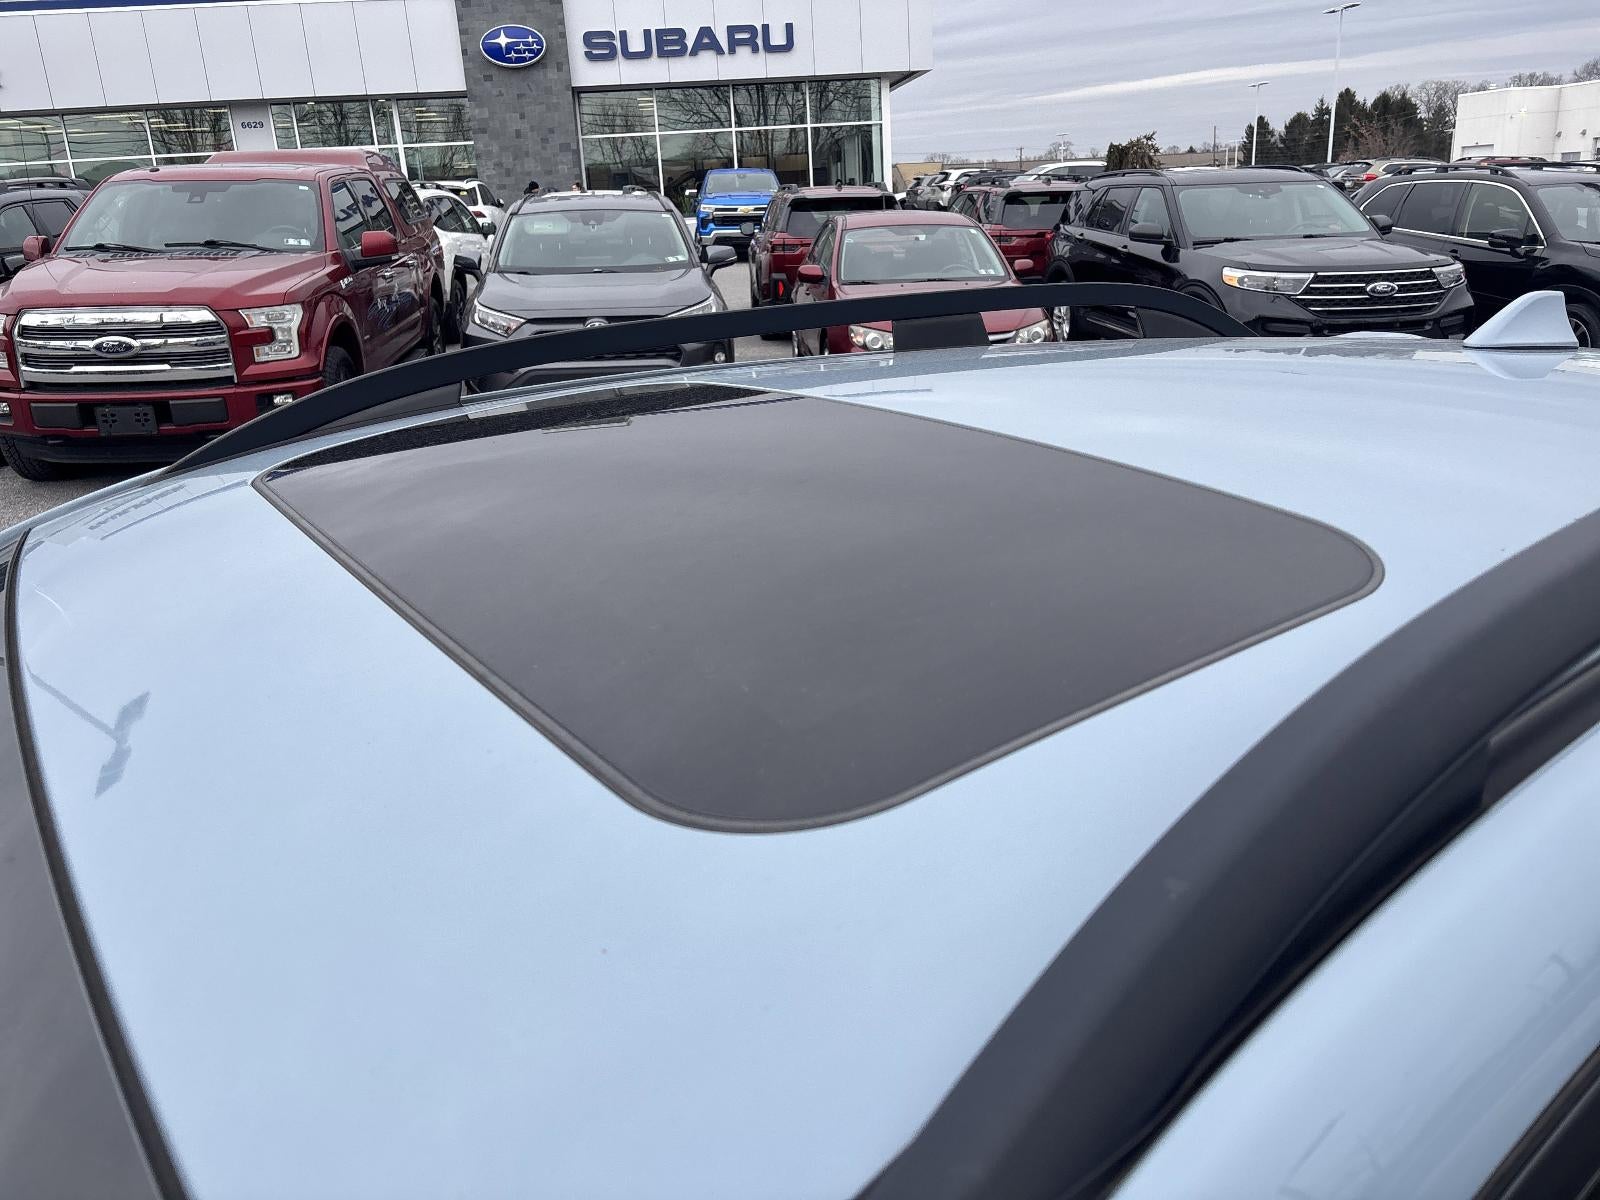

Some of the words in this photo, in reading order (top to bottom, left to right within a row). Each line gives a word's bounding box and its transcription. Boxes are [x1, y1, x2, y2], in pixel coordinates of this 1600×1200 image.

[582, 22, 794, 61] SUBARU
[241, 121, 264, 129] 6629
[101, 341, 126, 352] Ford
